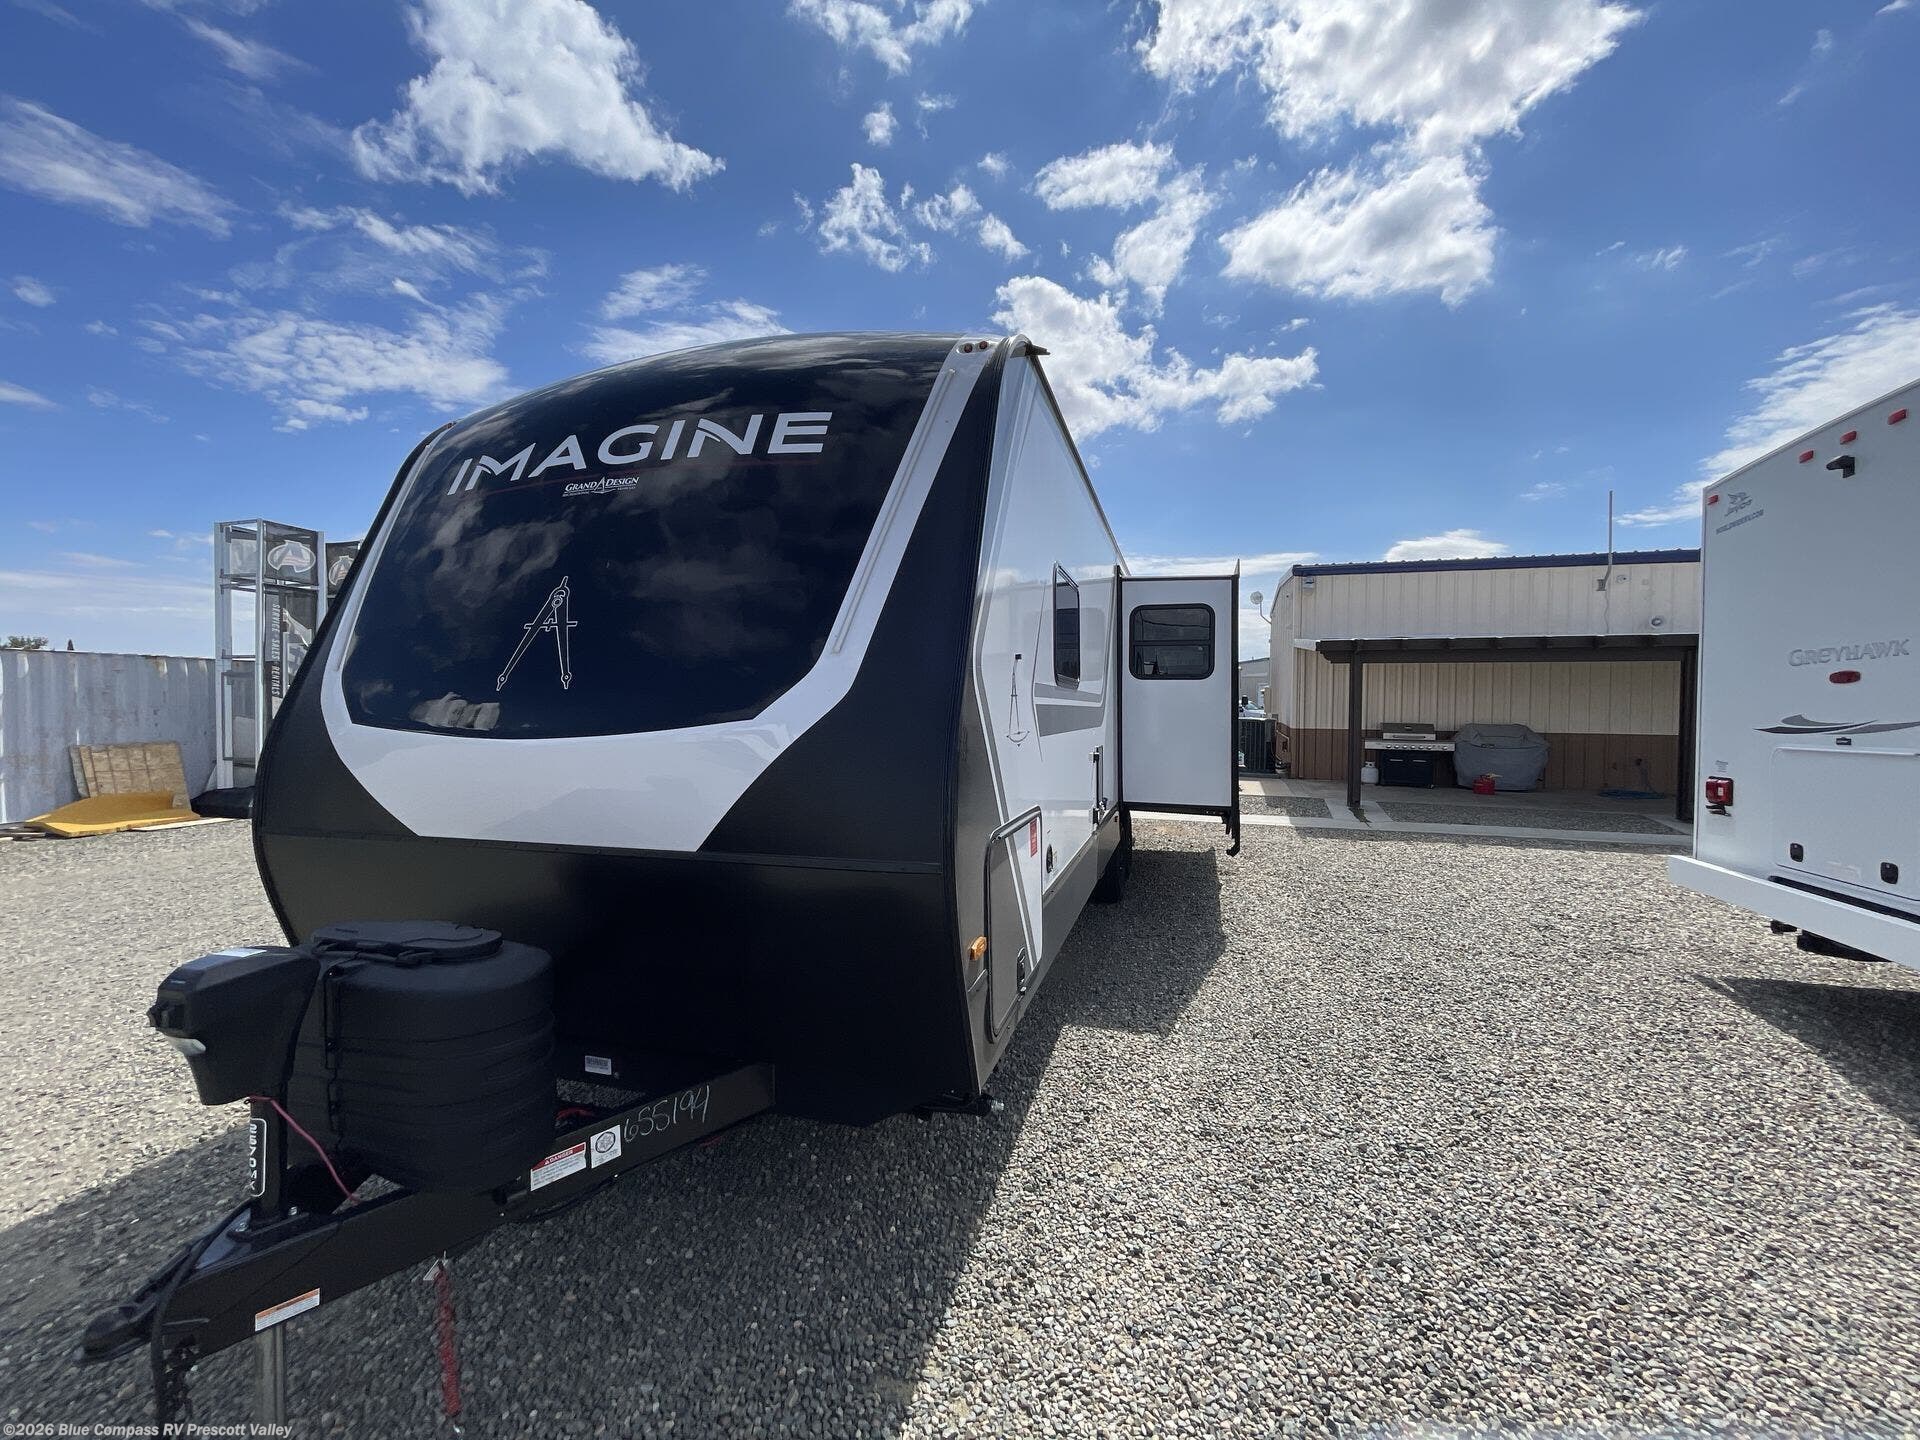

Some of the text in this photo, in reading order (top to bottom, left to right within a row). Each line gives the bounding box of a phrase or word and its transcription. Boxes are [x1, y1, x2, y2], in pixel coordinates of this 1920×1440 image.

[447, 411, 833, 496] IMAGINE
[565, 476, 640, 492] GRAND DESIGN
[271, 603, 281, 697] SERVICE SALES RENTALS
[1788, 639, 1910, 667] GREYHAWK
